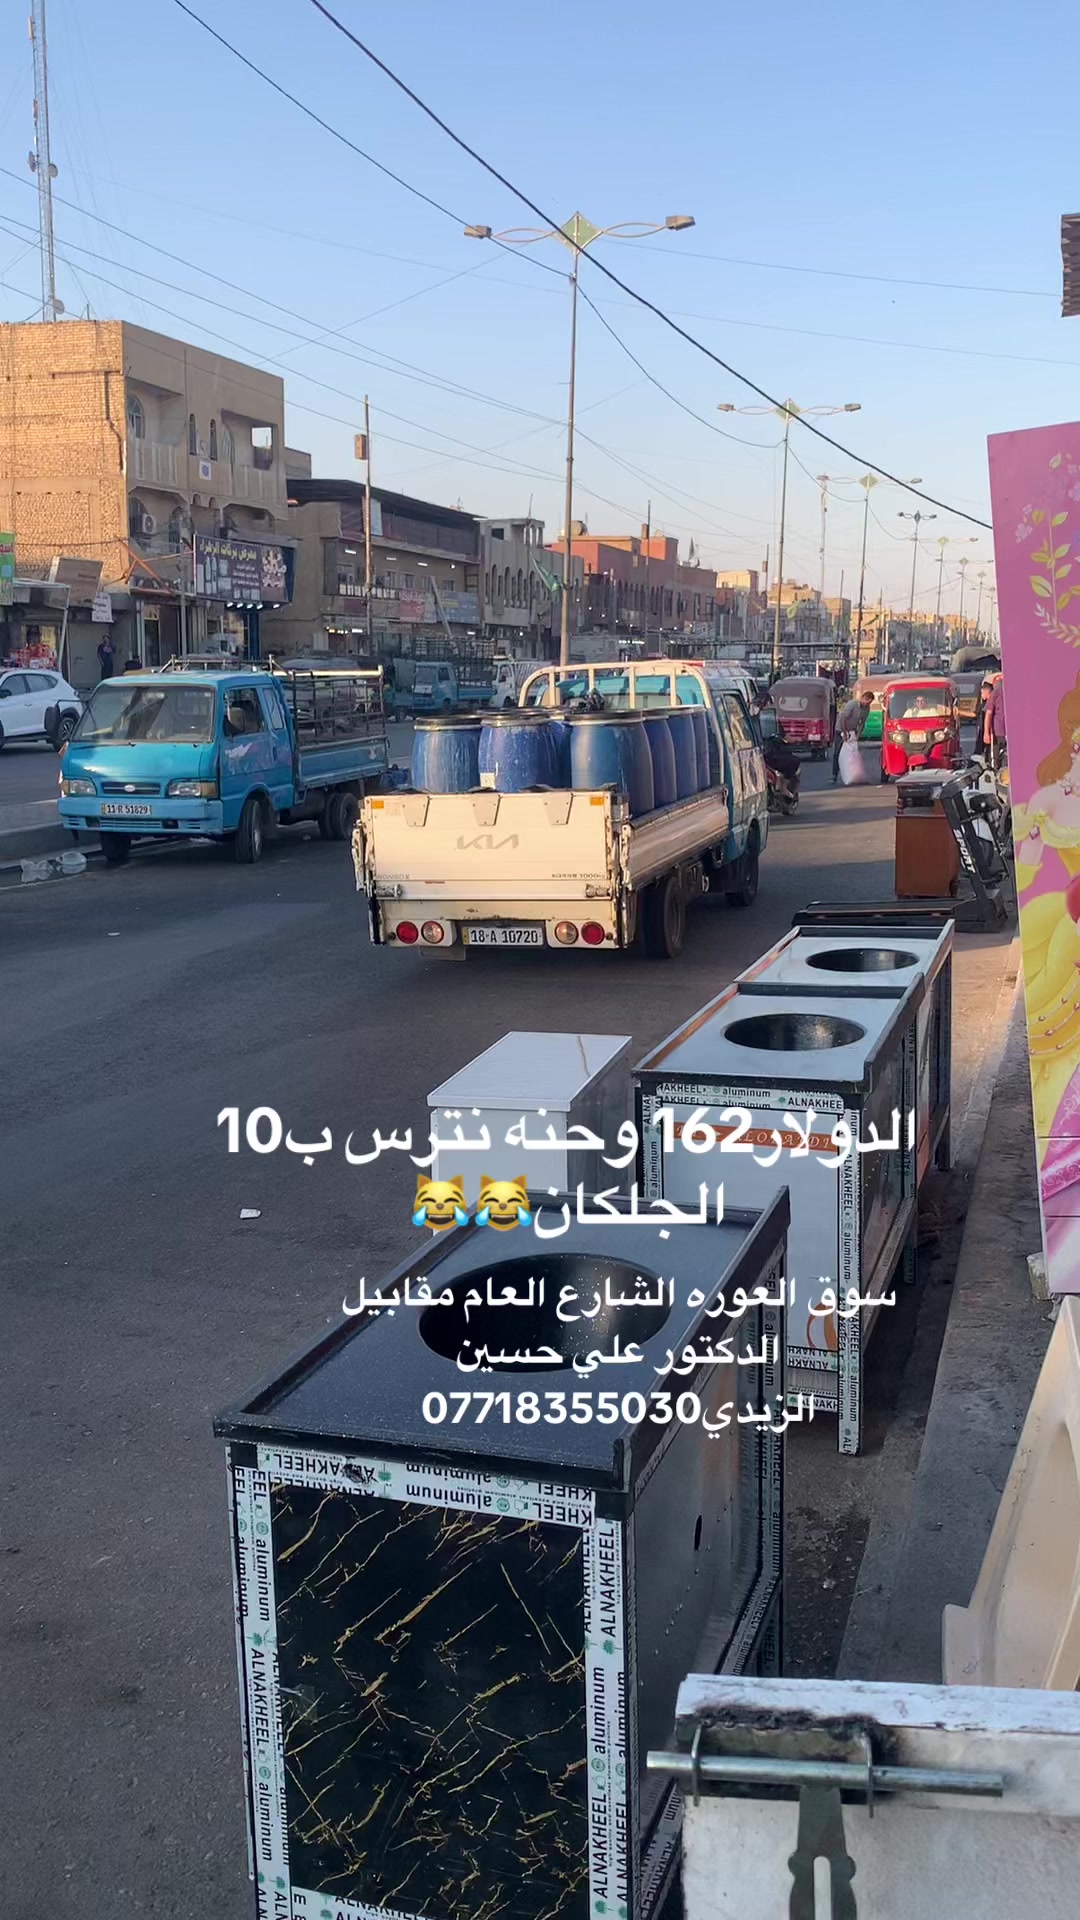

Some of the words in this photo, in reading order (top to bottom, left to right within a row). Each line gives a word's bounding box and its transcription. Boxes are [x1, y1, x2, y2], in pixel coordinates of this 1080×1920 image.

[501, 930, 538, 944] 10720
[722, 1087, 771, 1098] aluminum
[405, 1484, 492, 1510] aluminum
[532, 1503, 593, 1526] KHEEL
[255, 1539, 272, 1622] aluminum
[599, 1528, 616, 1638] ALNAKHEEL
[250, 1647, 270, 1746] ALNAKHEEL
[591, 1666, 606, 1755] aluminum
[258, 1782, 274, 1862] aluminum
[591, 1793, 609, 1899] ALNAKHEEL
